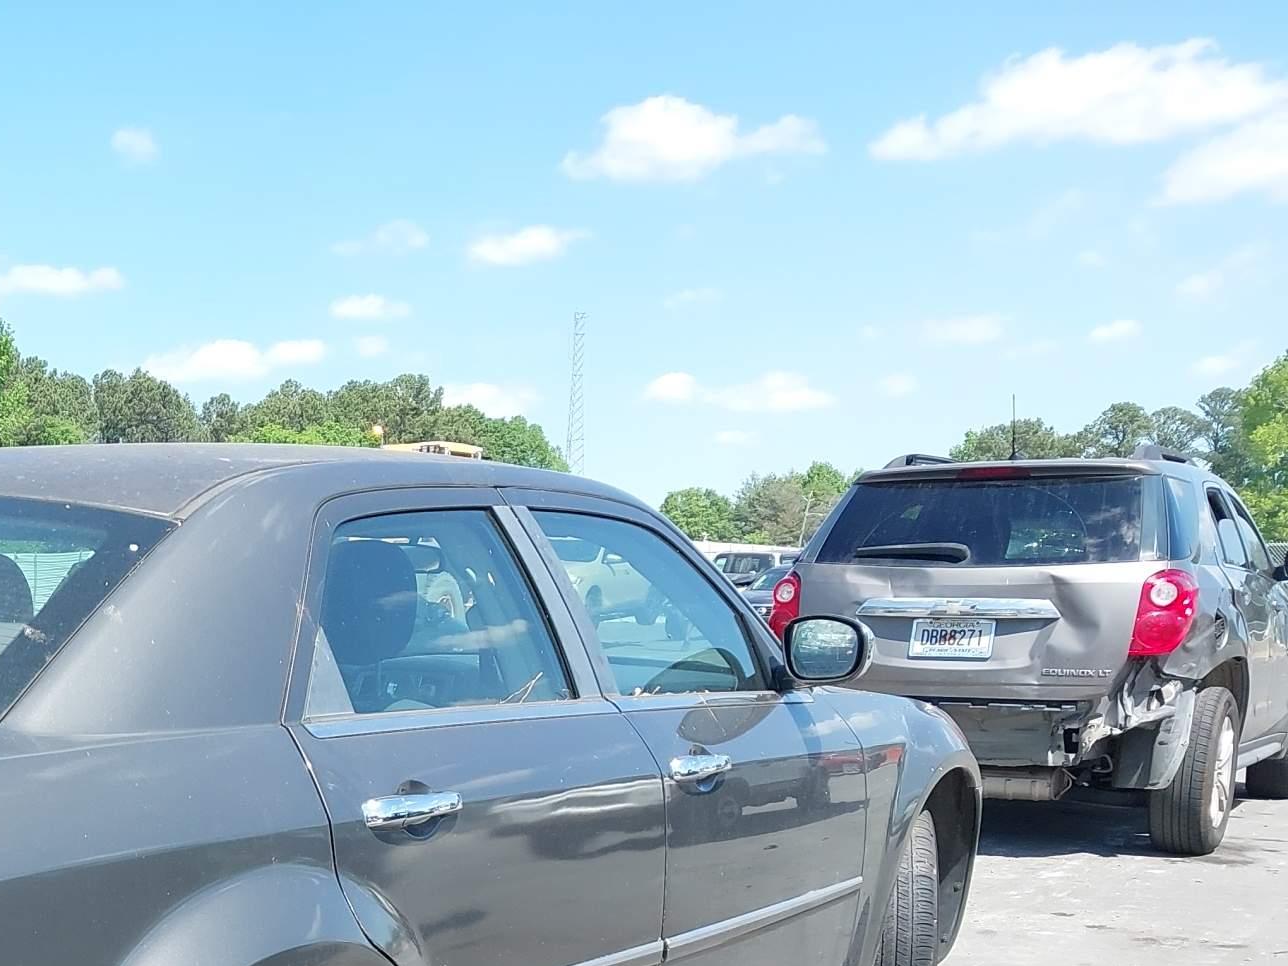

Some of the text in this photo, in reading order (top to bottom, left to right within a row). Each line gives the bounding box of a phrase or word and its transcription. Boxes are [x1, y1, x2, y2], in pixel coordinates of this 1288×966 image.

[920, 629, 983, 646] DBB8271
[1041, 668, 1113, 677] EQUINOX LT
